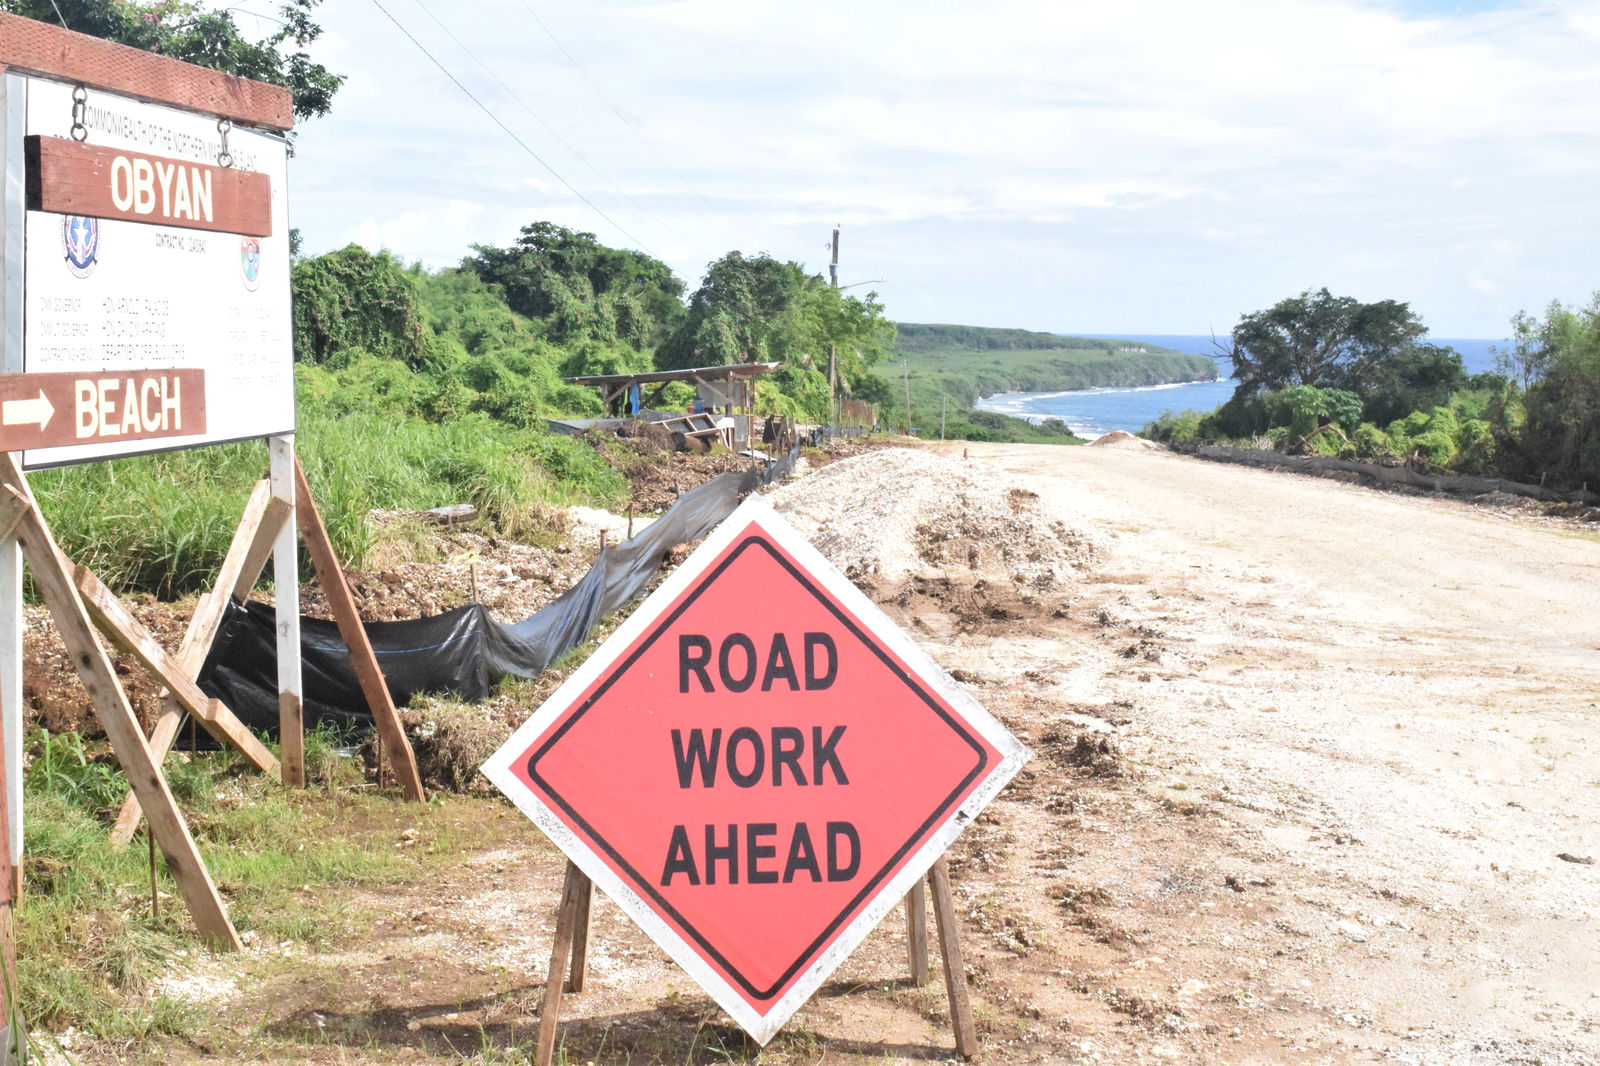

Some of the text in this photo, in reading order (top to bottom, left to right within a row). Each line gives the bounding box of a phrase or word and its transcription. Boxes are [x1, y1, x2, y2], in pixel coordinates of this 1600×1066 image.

[149, 123, 157, 145] OF
[159, 127, 171, 150] THE
[111, 156, 214, 223] OBYAN
[75, 377, 182, 439] BEACH
[679, 632, 838, 693] ROAD
[671, 725, 849, 788] WORK
[660, 821, 862, 886] AHEAD
